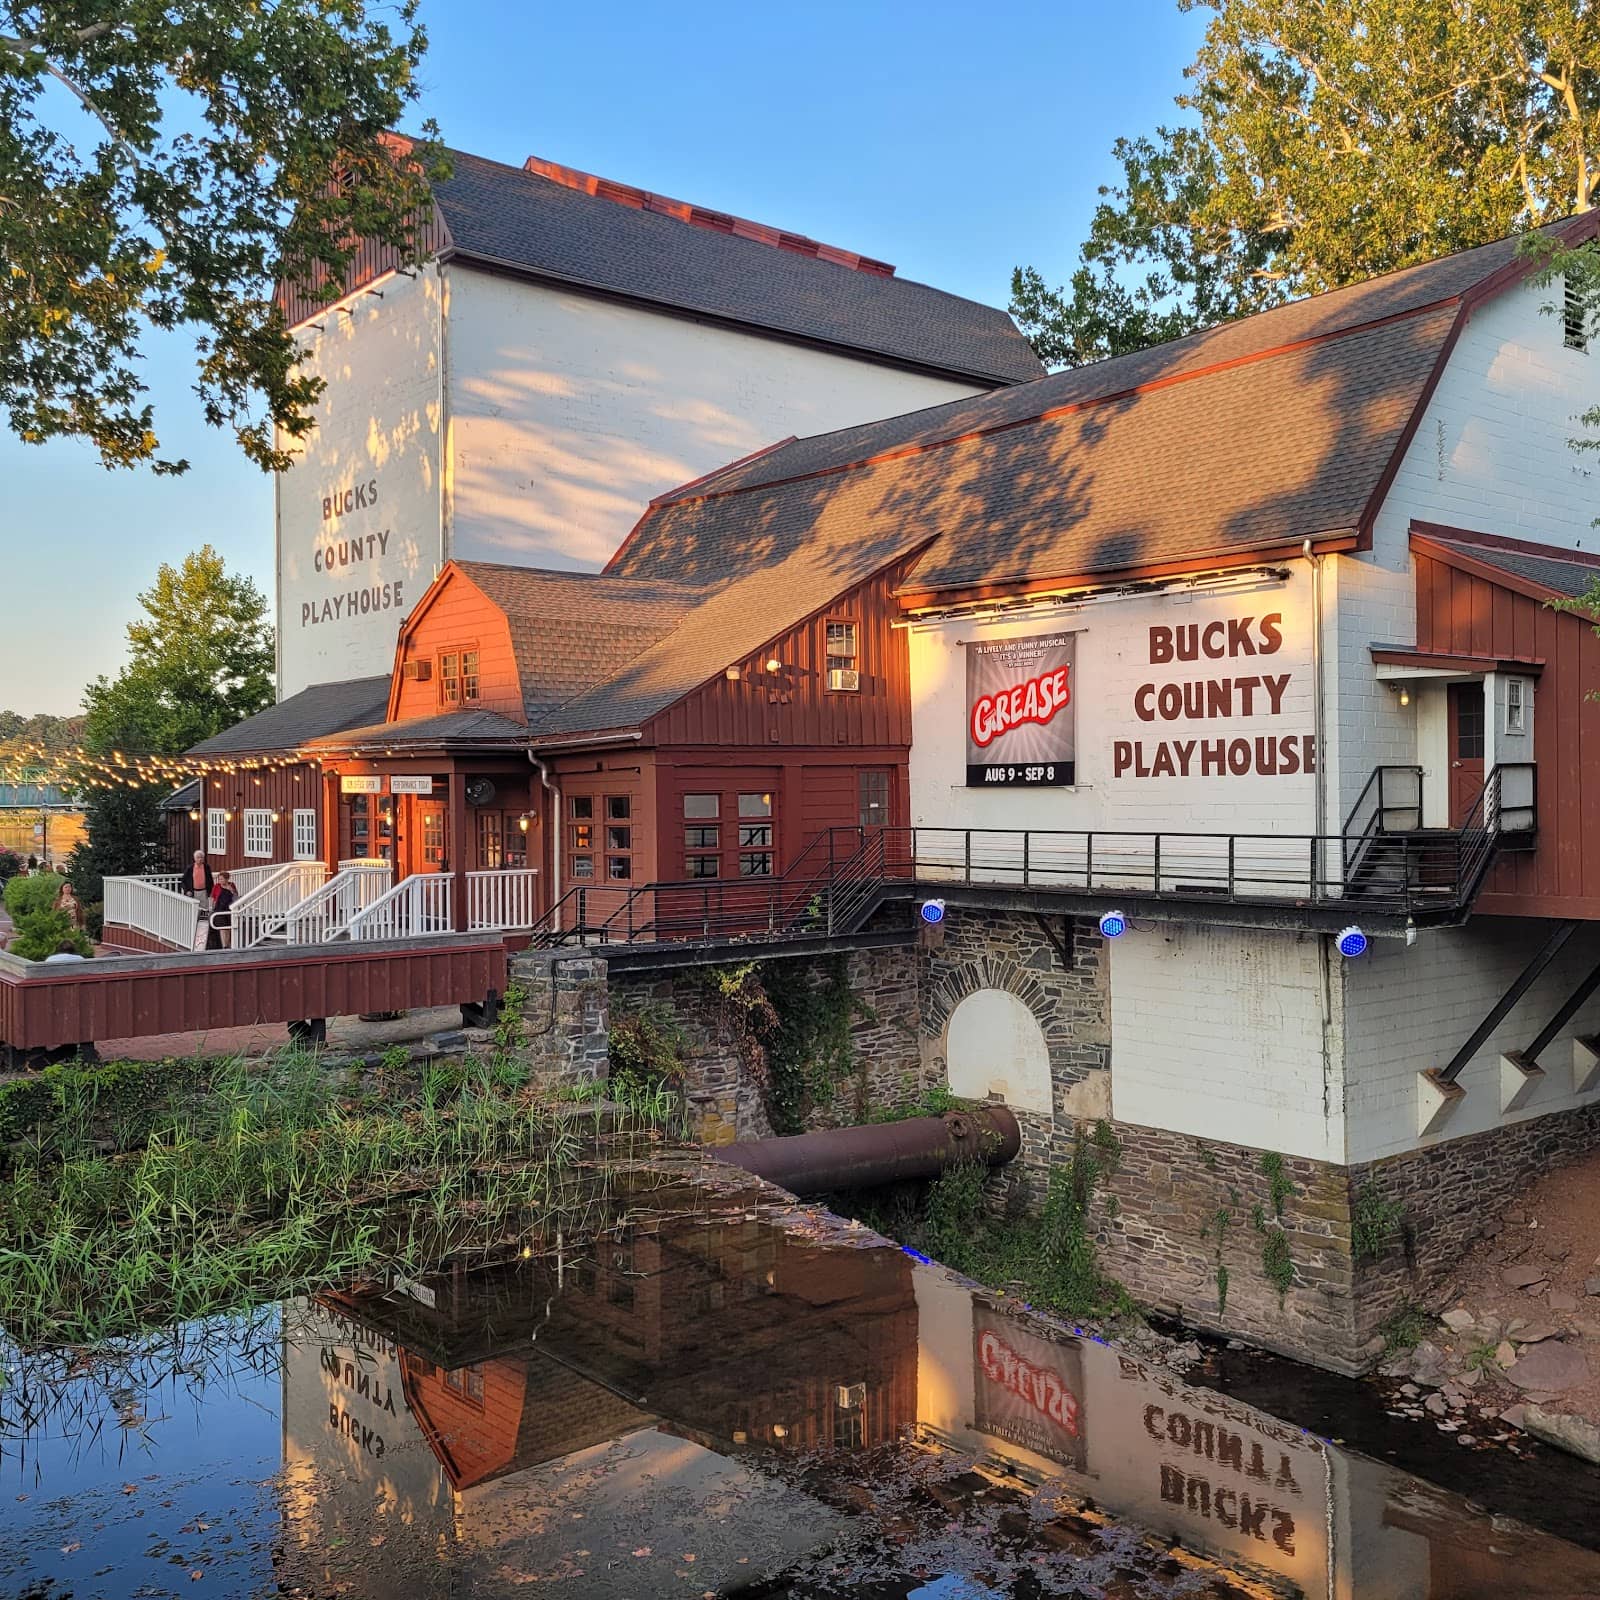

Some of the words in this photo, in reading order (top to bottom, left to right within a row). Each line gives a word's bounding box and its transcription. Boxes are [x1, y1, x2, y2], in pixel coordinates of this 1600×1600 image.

[323, 479, 378, 521] BUCKS
[314, 529, 391, 573] COUNTY
[302, 580, 404, 628] PLAYHOUSE
[983, 645, 1003, 655] LIVELY
[1004, 643, 1016, 652] AND
[1017, 641, 1038, 651] FUNNY
[1039, 638, 1067, 648] MUSICAL
[1149, 613, 1282, 665] BUCKS
[973, 669, 1068, 743] GREASE
[1134, 673, 1292, 722] COUNTY
[984, 767, 1006, 782] AUG
[1007, 766, 1016, 781] 9
[1024, 766, 1045, 781] SEP
[1046, 765, 1055, 780] 8
[1113, 734, 1316, 778] PLAYHOUSE
